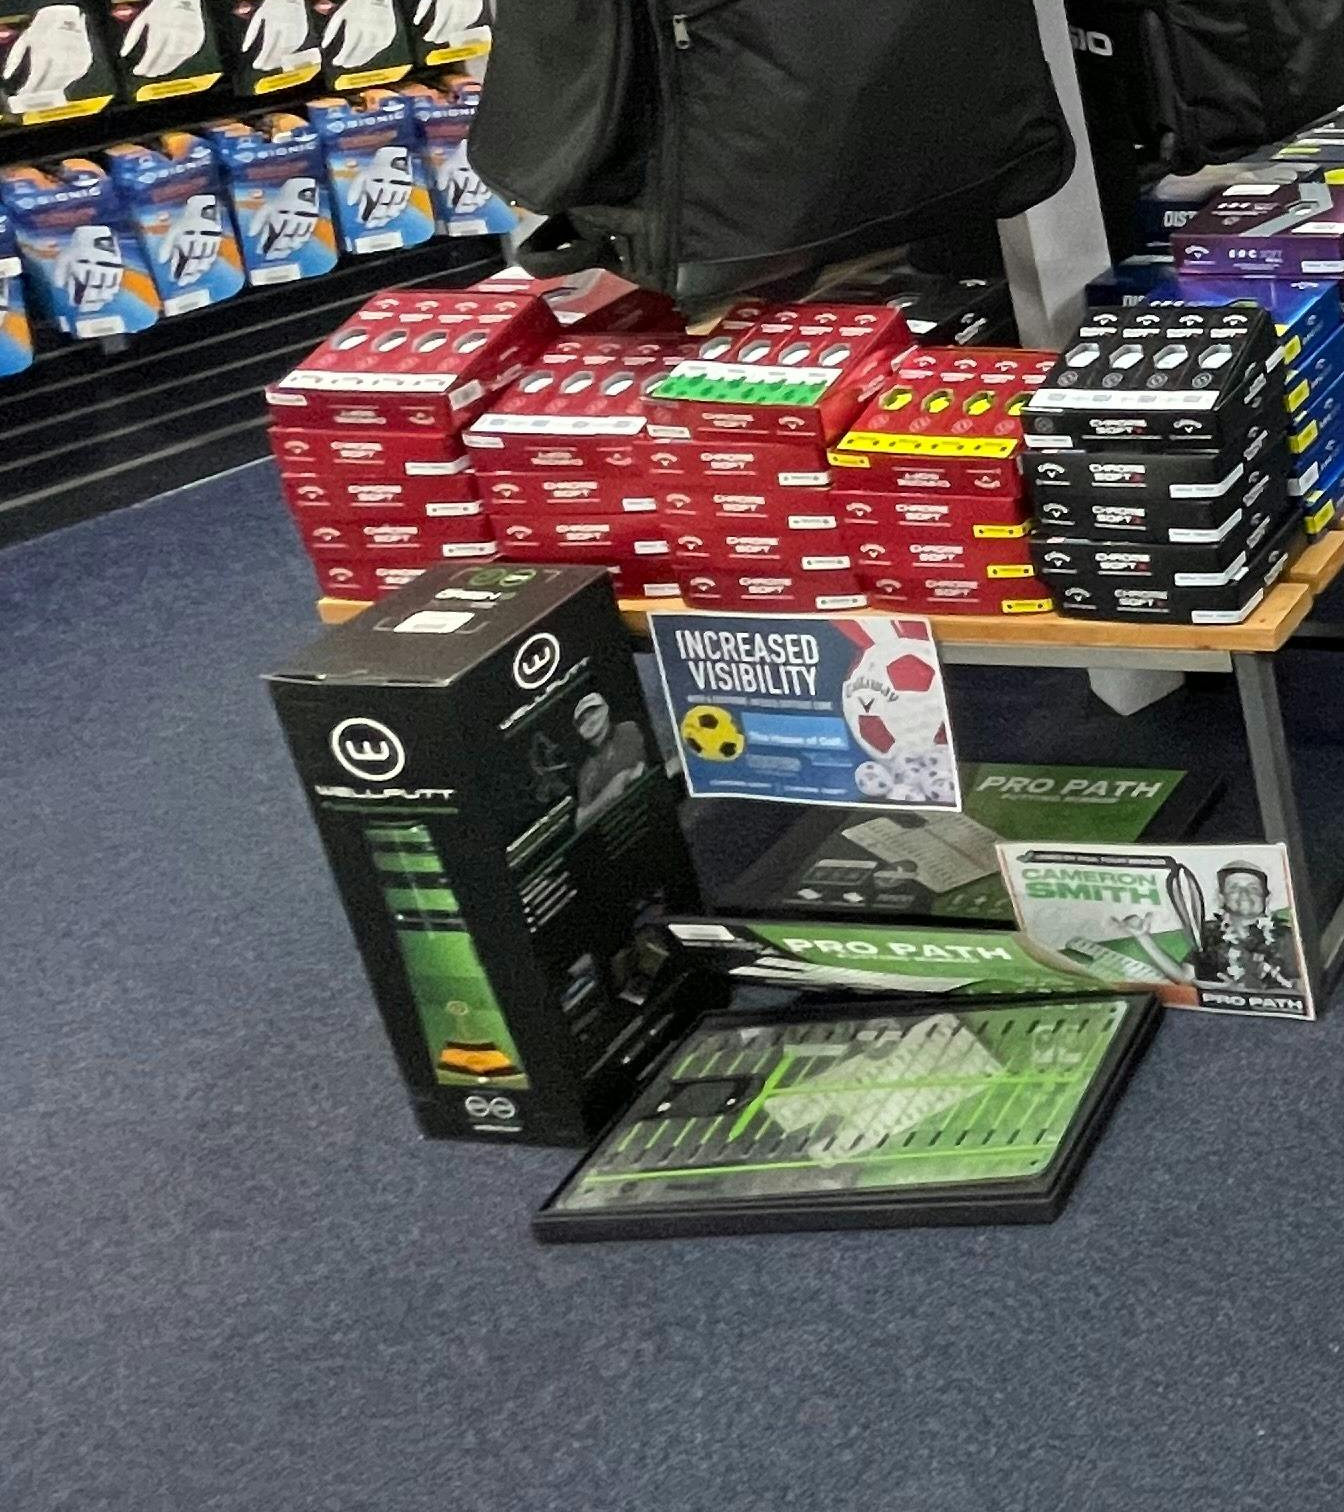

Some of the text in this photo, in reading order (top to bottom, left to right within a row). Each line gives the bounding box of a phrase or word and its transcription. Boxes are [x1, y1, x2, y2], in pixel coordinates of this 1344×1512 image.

[676, 630, 819, 665] INCREASED
[689, 661, 816, 696] VISIBILITY
[977, 776, 1057, 793] PRO
[1062, 778, 1163, 800] PATH
[1020, 867, 1156, 886] CAMERON
[1025, 882, 1161, 904] SMITH
[783, 938, 886, 958] PRO
[890, 941, 1013, 962] PATH
[1203, 993, 1303, 1010] PRO PATH
